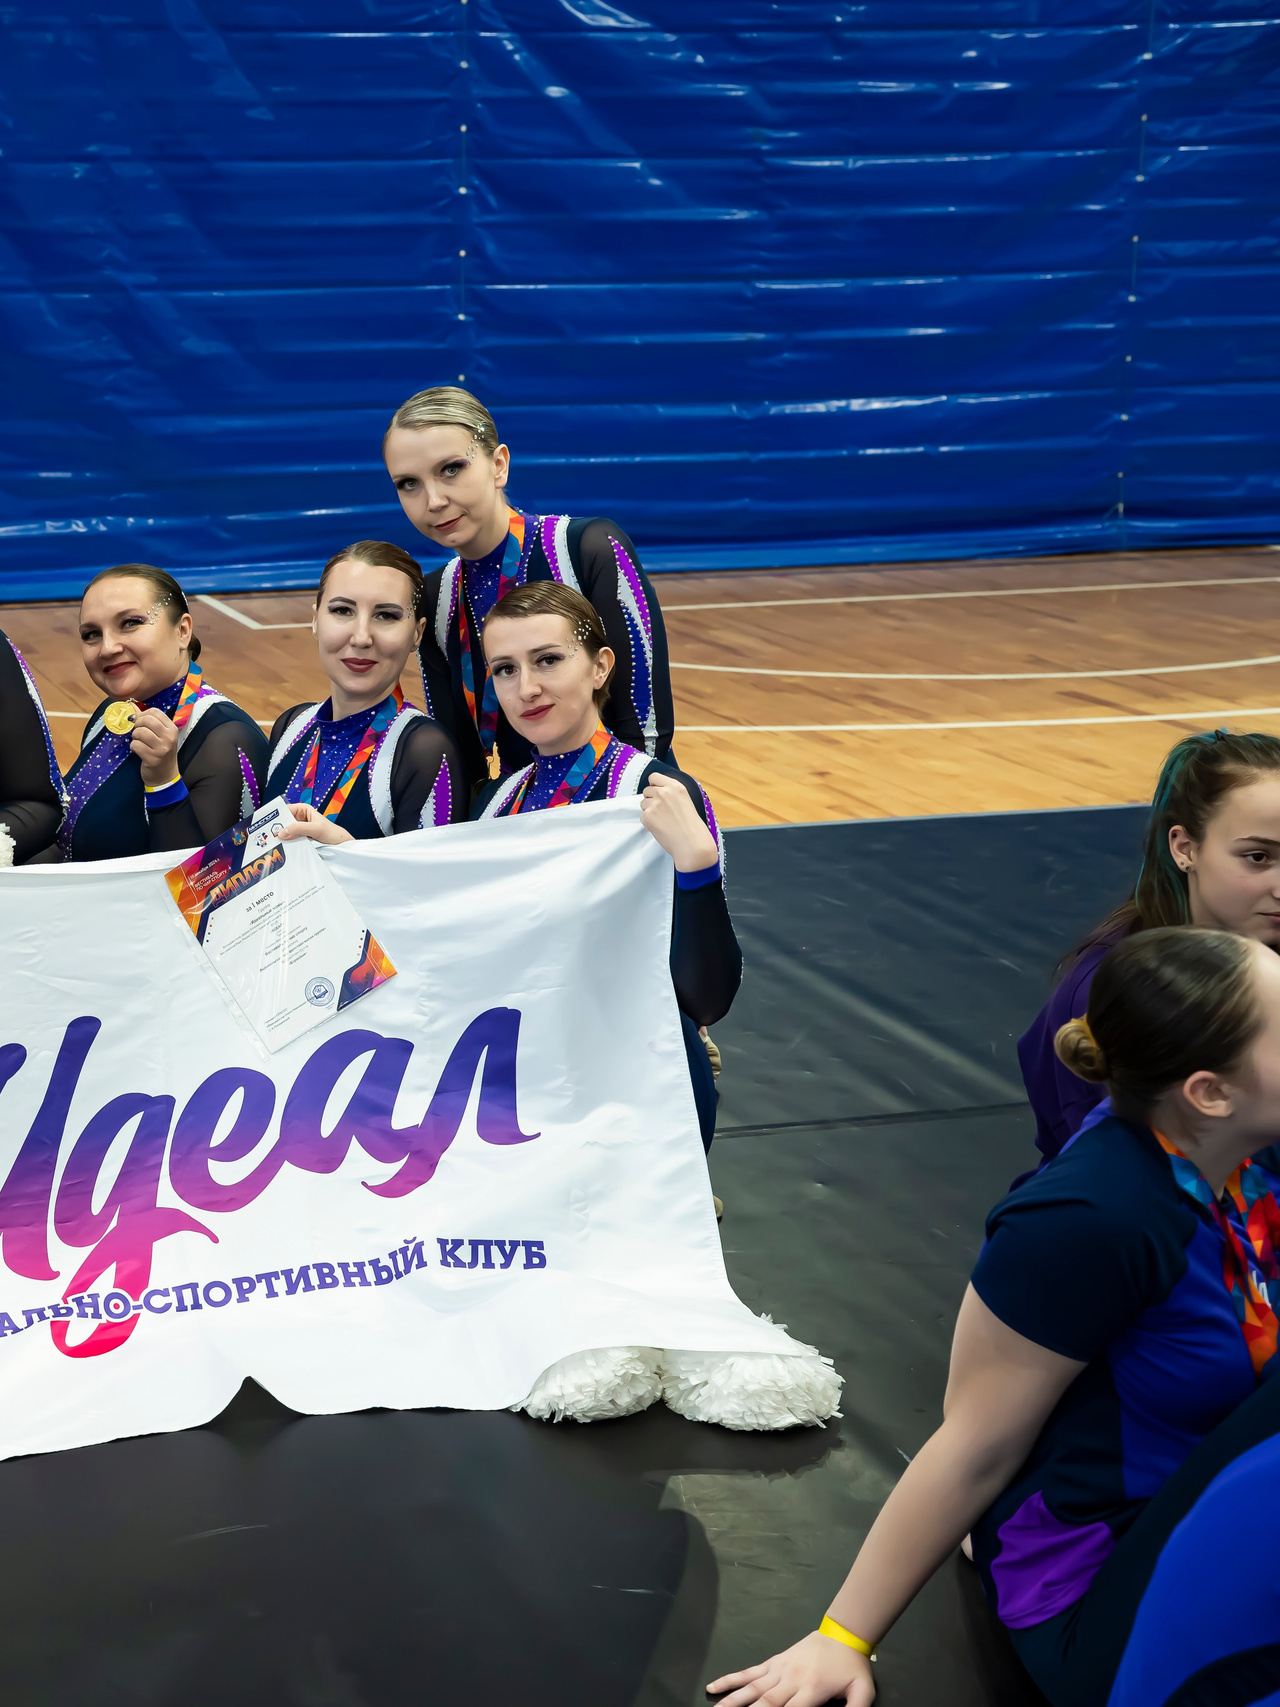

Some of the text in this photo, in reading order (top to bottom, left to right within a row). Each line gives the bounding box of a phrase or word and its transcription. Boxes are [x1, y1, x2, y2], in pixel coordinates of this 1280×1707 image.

[194, 870, 218, 888] ФЕСТИВАЛЬ
[209, 848, 283, 906] ДИПЛОМ
[210, 868, 227, 882] СПОРТУ
[255, 891, 274, 906] место
[436, 1237, 547, 1271] КЛУБ
